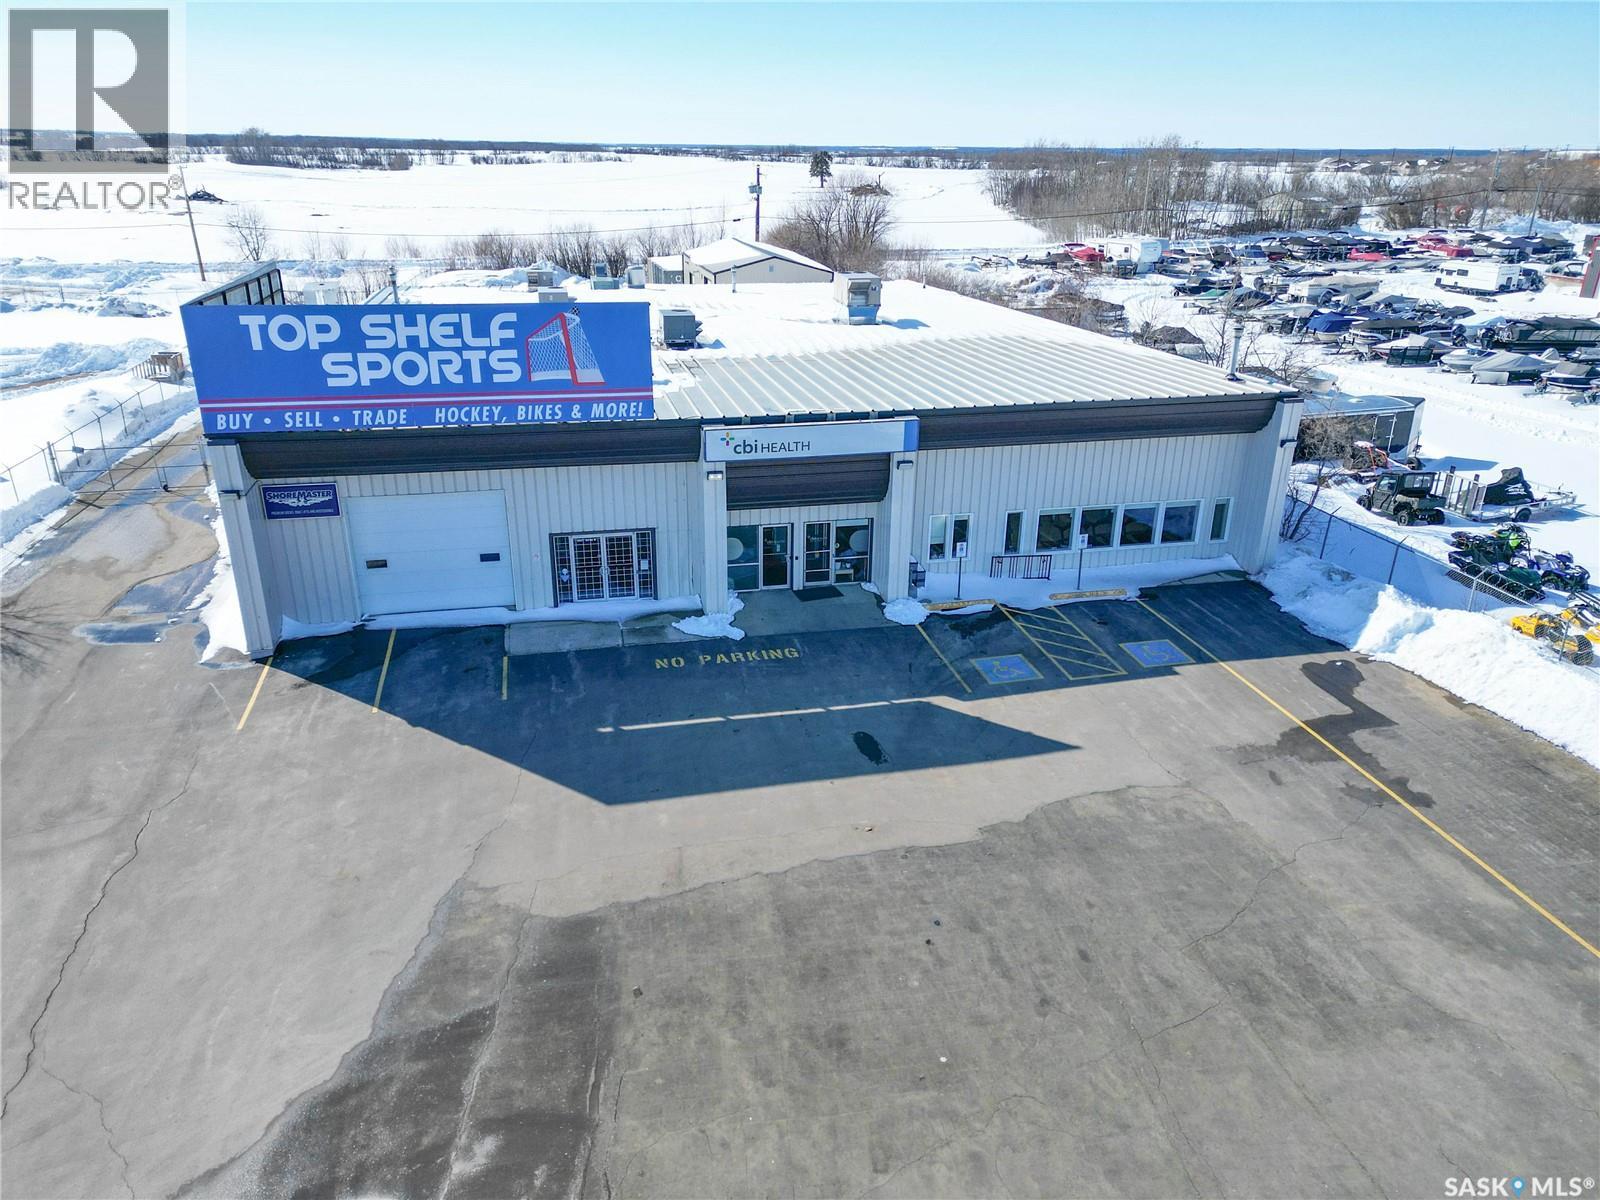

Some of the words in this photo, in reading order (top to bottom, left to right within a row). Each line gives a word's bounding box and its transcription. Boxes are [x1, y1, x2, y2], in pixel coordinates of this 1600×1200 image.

[239, 315, 340, 351] TOP
[360, 312, 517, 349] SHELF
[321, 350, 522, 387] SPORTS
[216, 414, 253, 430] BUY
[284, 411, 323, 428] SELL
[353, 409, 407, 425] TRADE
[435, 405, 506, 424] HOCKEY,
[517, 404, 562, 421] BIKES
[571, 404, 582, 419] &
[591, 402, 643, 418] MORE!
[733, 440, 758, 454] cbi
[761, 441, 811, 453] HEALTH
[266, 490, 332, 501] SHOREMASTER
[655, 657, 685, 669] NO
[699, 648, 799, 665] PARKING
